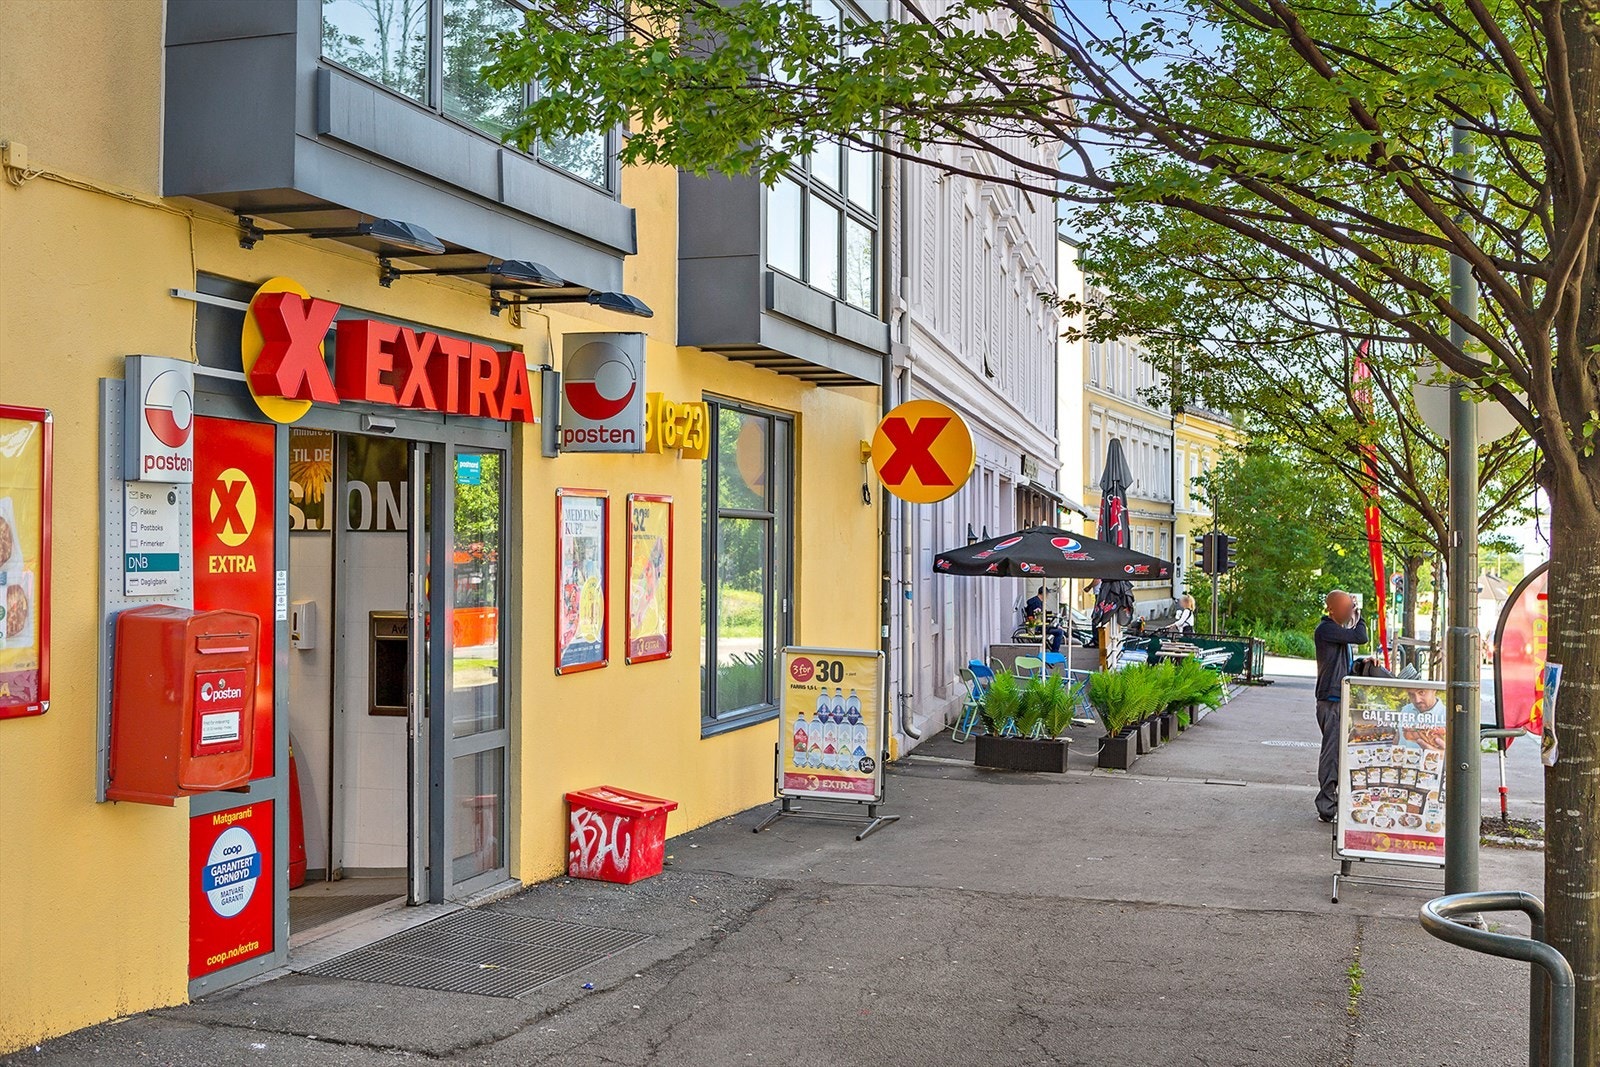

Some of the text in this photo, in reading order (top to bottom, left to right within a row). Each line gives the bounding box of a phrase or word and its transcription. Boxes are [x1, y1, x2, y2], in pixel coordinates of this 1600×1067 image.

[252, 291, 536, 424] X EXTRA
[563, 425, 636, 447] posten
[293, 448, 311, 462] TIL
[879, 417, 955, 486] X
[144, 452, 192, 474] posten
[139, 491, 153, 500] Brev
[139, 508, 157, 516] Pakker
[210, 480, 250, 535] X
[632, 507, 645, 532] 32
[140, 524, 164, 533] Postboks
[139, 539, 165, 548] Frimerker
[128, 555, 149, 571] DNB
[208, 555, 257, 574] EXTRA
[140, 577, 168, 588] Dagligbank
[792, 663, 811, 676] 3 for
[815, 659, 844, 683] 30
[212, 687, 242, 702] posten
[1362, 710, 1383, 721] GAL
[1384, 711, 1415, 722] ETTER
[822, 779, 855, 790] EXTRA
[212, 806, 253, 826] Matgaranti
[223, 844, 243, 856] coop
[1395, 839, 1437, 851] EXTRA
[211, 856, 254, 877] GARANTERT
[214, 867, 250, 887] FORNØYD
[220, 885, 244, 899] MATVARE
[221, 893, 244, 906] GARANTI
[206, 939, 260, 967] coop.no/extra
